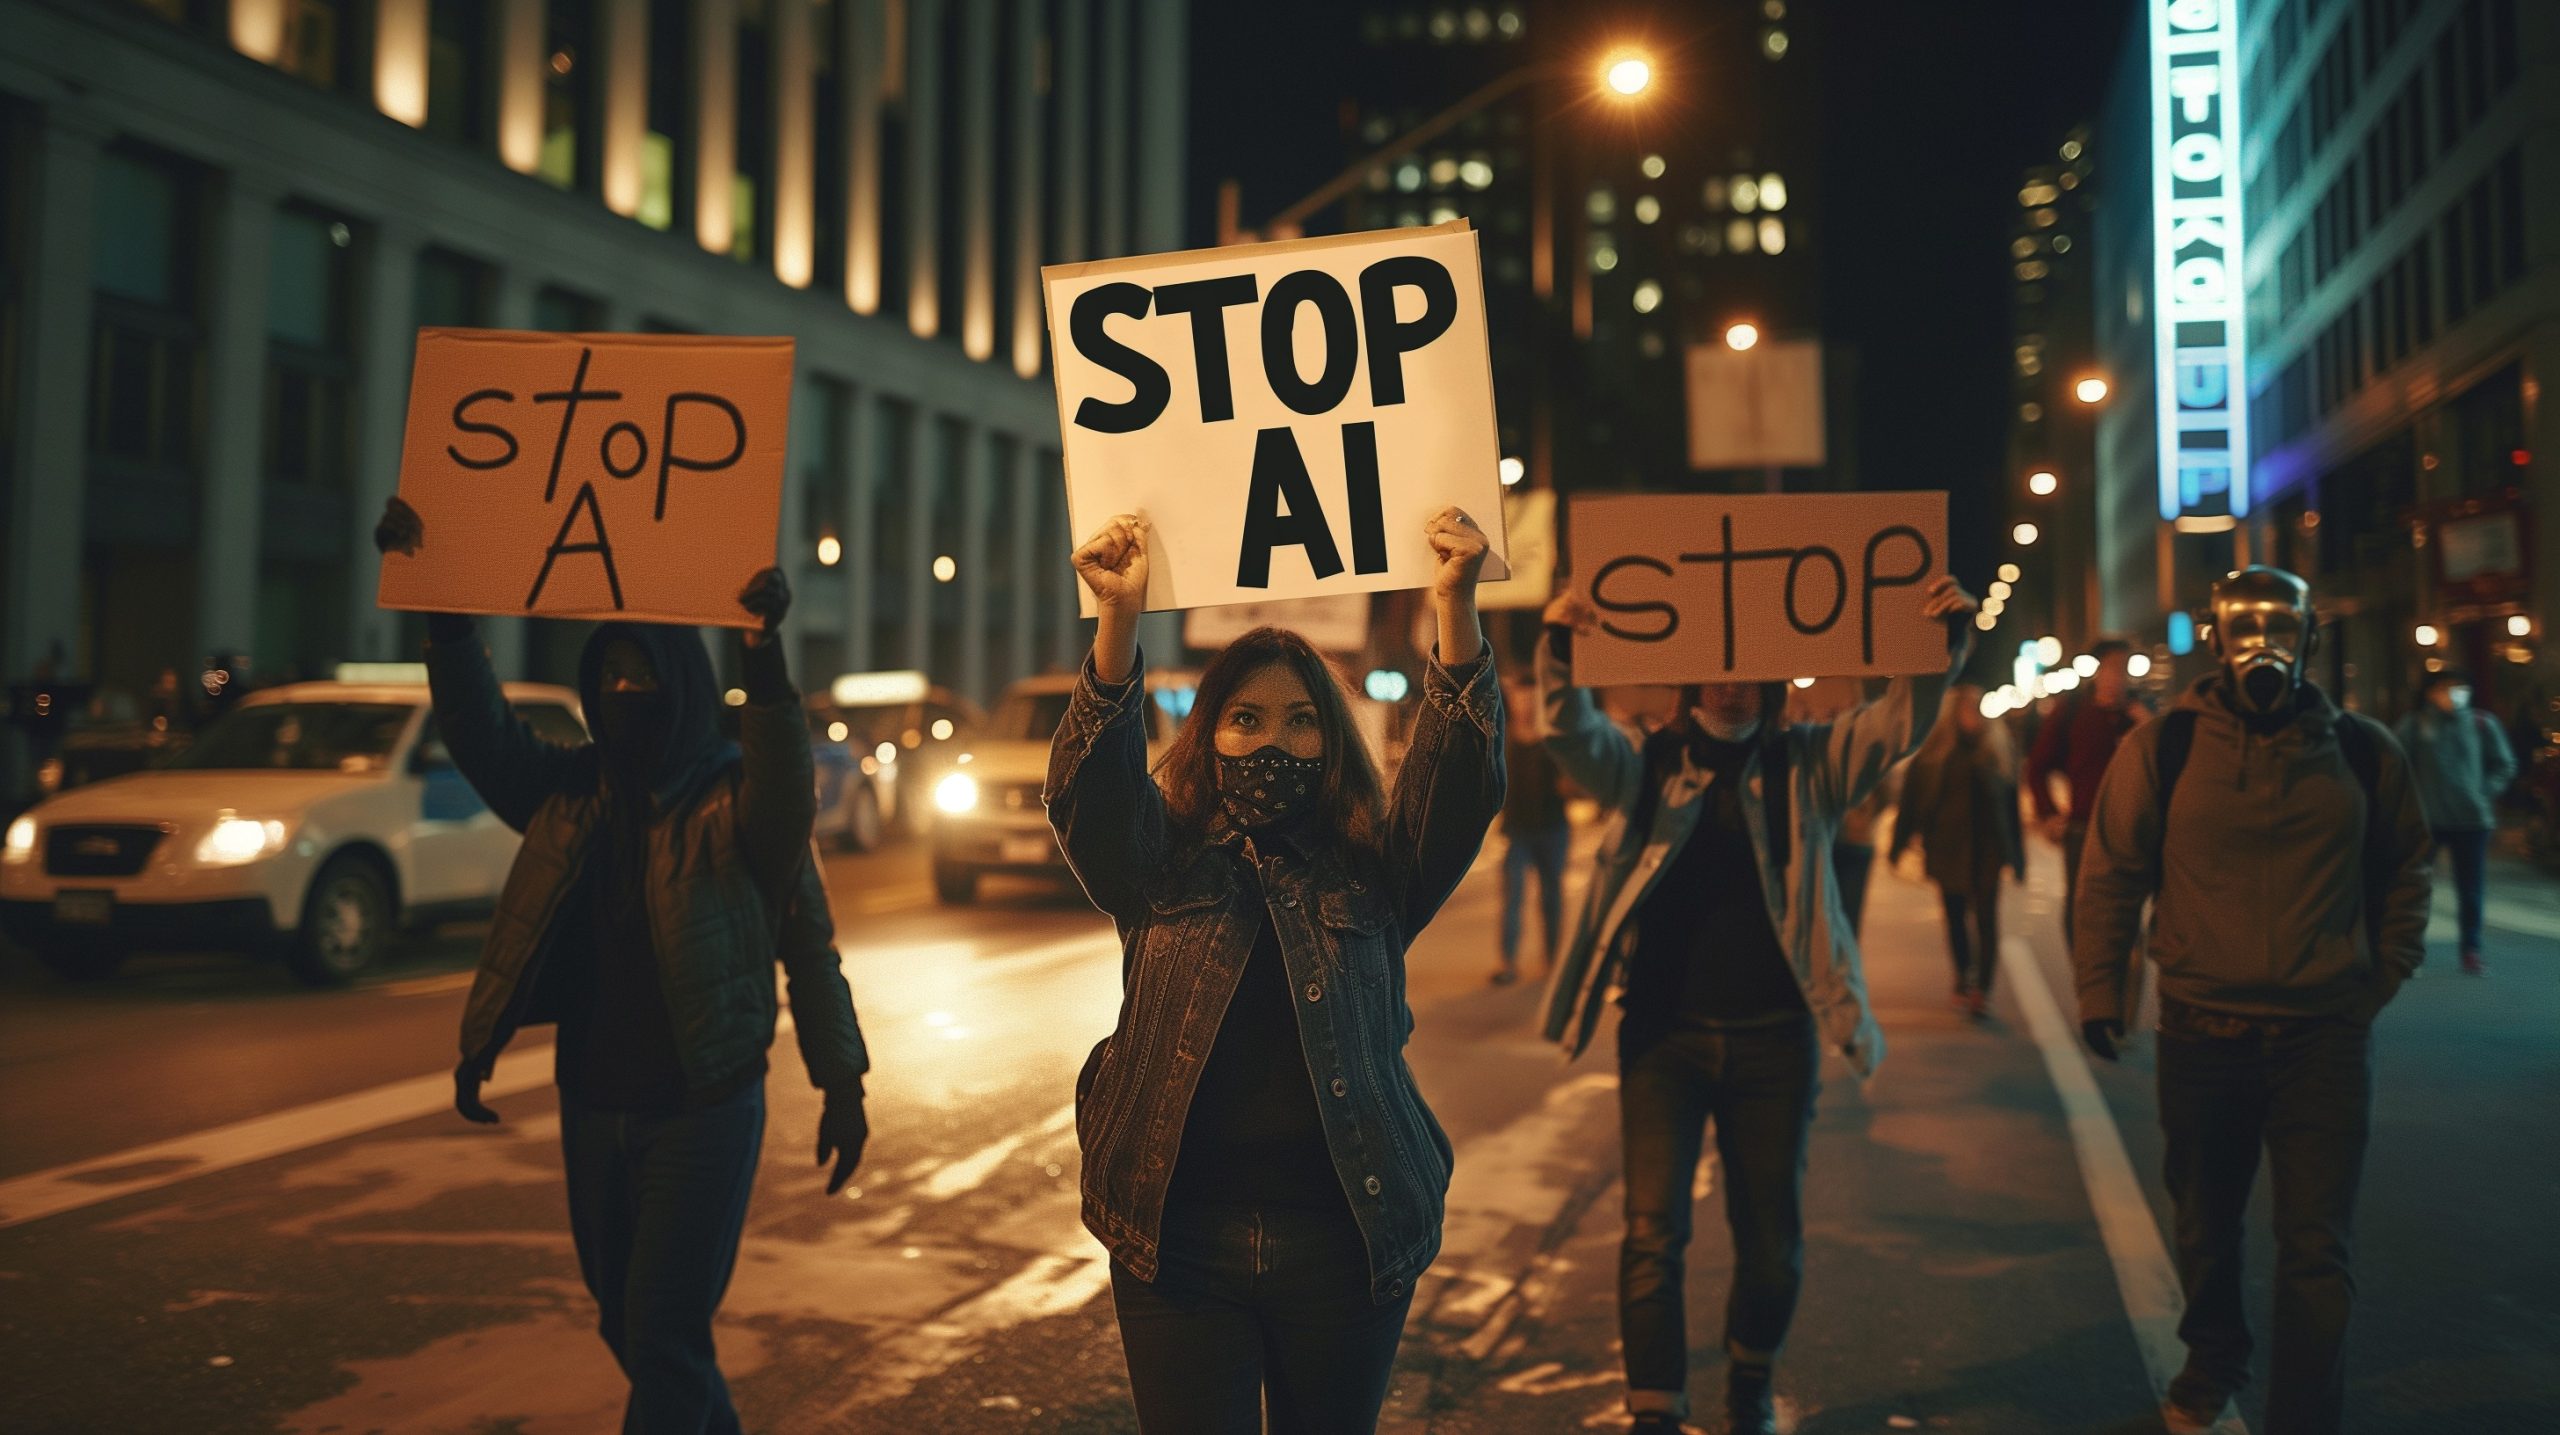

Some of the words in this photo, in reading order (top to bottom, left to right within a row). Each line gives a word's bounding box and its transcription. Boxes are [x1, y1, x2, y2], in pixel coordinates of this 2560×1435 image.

[1069, 256, 1458, 434] STOP
[524, 481, 625, 611] A
[1236, 421, 1389, 589] AI
